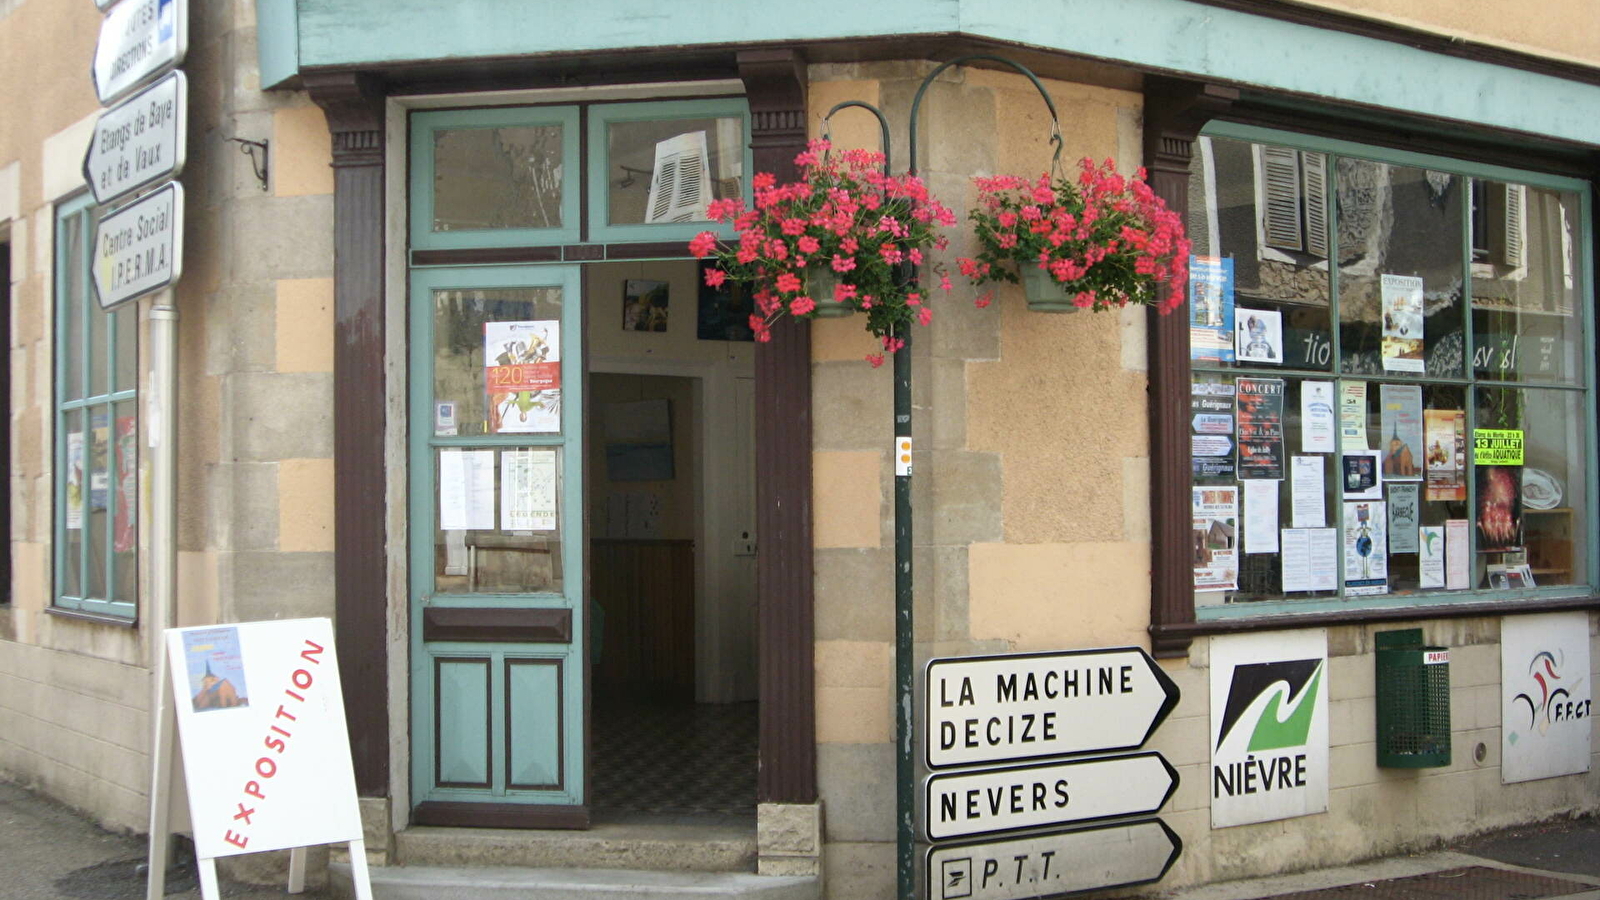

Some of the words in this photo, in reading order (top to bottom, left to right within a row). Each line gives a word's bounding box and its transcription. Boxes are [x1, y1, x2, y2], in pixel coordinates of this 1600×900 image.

[100, 121, 131, 154] Etangs
[134, 110, 145, 134] de
[149, 98, 172, 129] Baye
[101, 165, 111, 190] et
[116, 155, 129, 182] de
[135, 143, 161, 172] Vaux
[103, 227, 132, 258] Centre
[136, 202, 168, 241] Social
[492, 366, 523, 385] 120
[1239, 383, 1281, 394] CONCERT
[1475, 439, 1488, 449] 13
[1491, 439, 1520, 449] JUILLET
[940, 677, 975, 708] LA
[996, 665, 1133, 703] MACHINE
[224, 639, 325, 849] EXPOSITION
[940, 712, 1057, 750] DECIZE
[941, 779, 1070, 822] NEVERS
[981, 851, 1060, 889] P.T.T.
